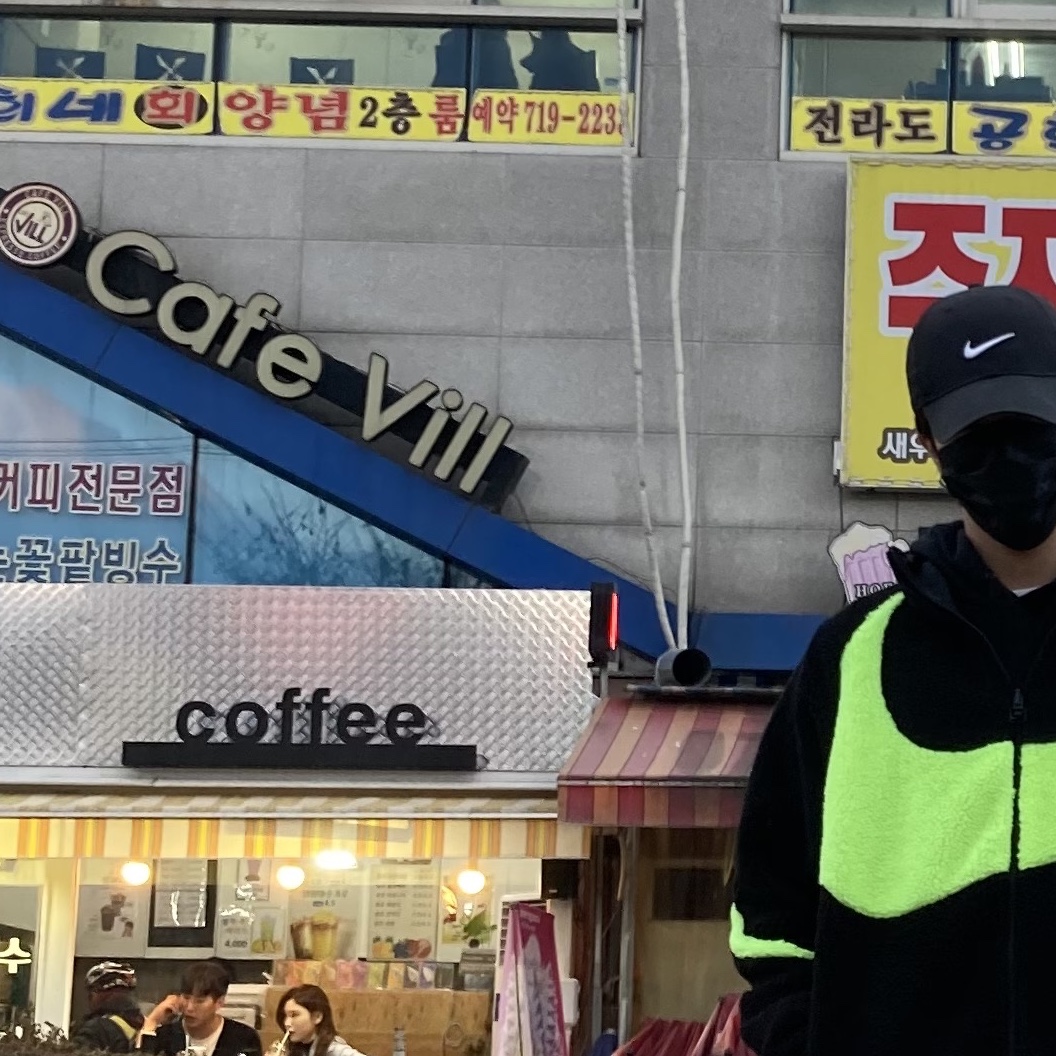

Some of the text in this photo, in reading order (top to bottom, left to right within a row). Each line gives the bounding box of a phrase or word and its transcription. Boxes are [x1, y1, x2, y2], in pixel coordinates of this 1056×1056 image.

[146, 89, 197, 126] 회
[223, 84, 351, 134] 양념
[358, 90, 422, 136] 2층
[428, 94, 466, 135] 룸
[472, 96, 519, 134] 예약
[524, 101, 625, 135] 719-223
[804, 100, 936, 148] 전라도
[86, 229, 514, 494] Cafe Vill
[176, 687, 429, 746] coffee
